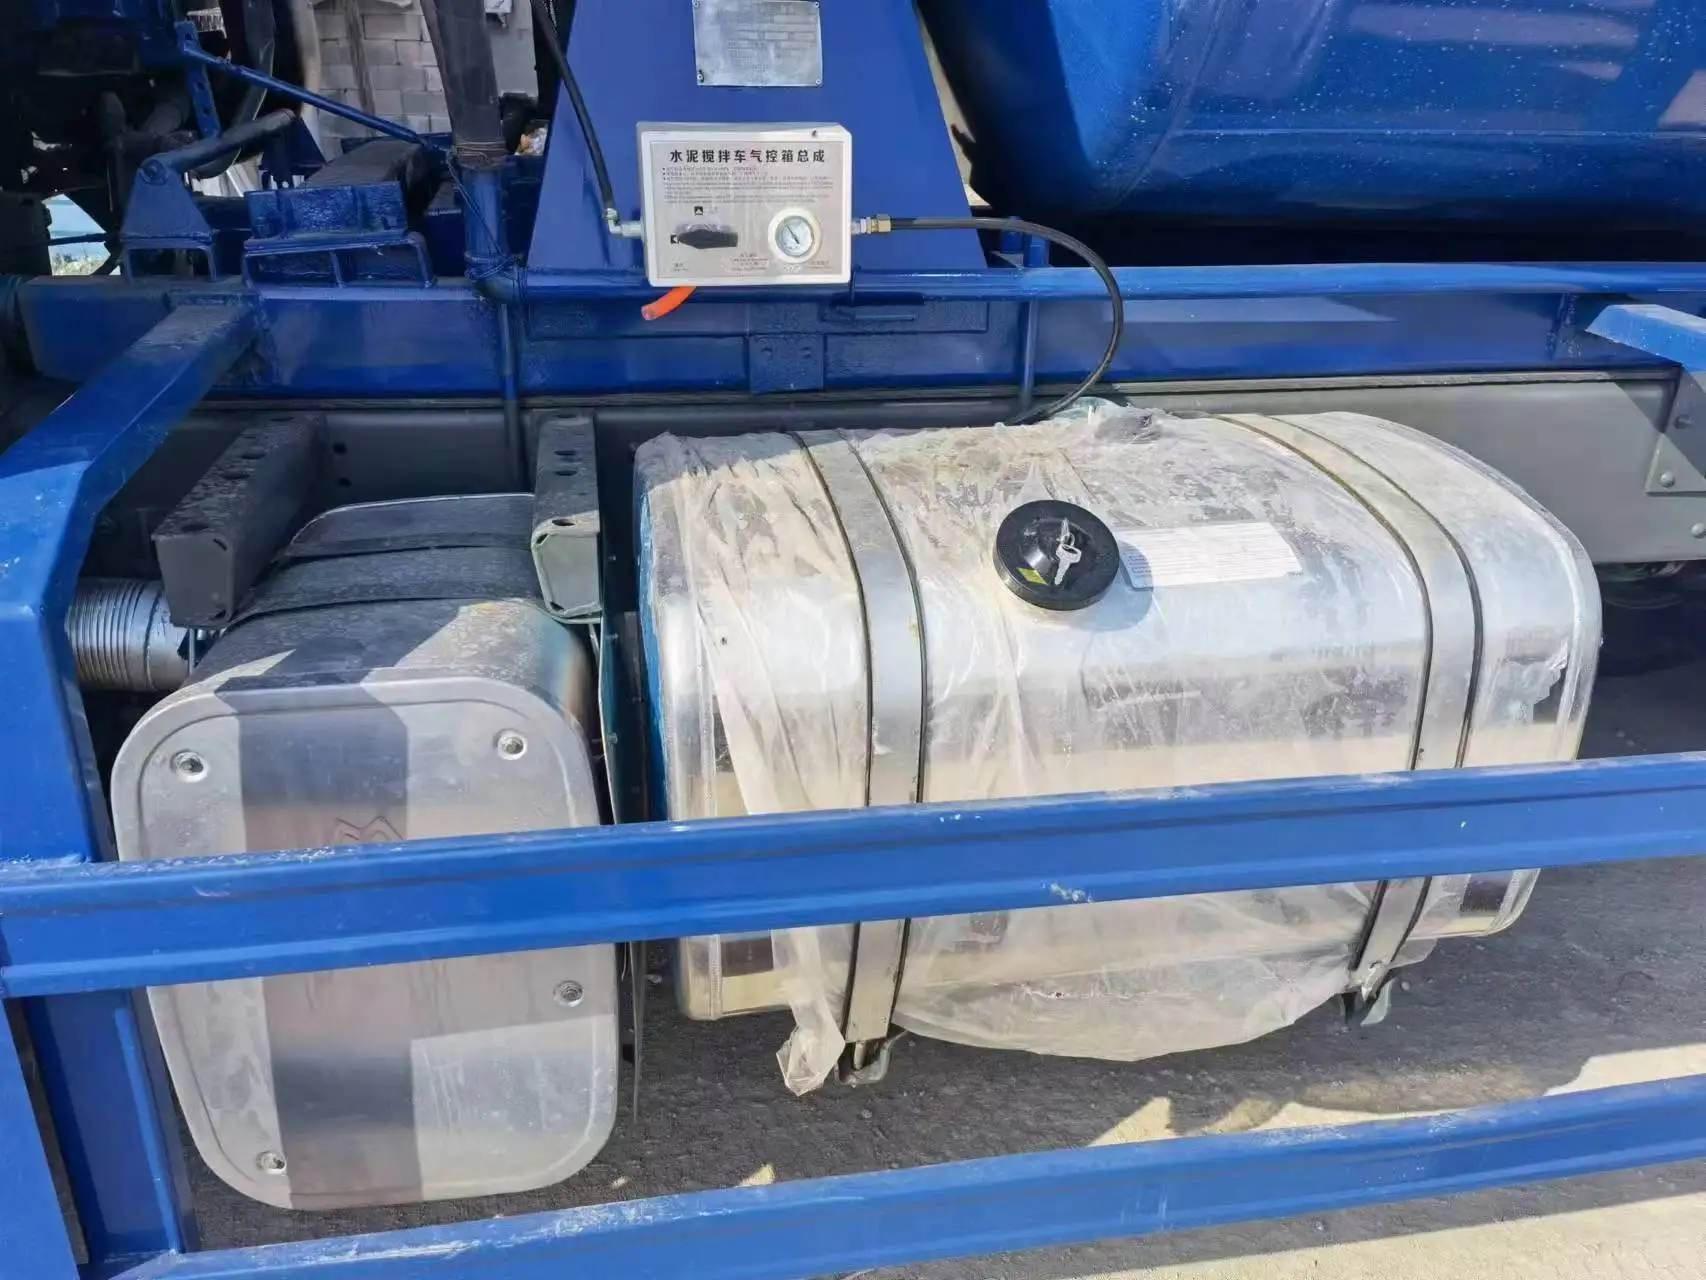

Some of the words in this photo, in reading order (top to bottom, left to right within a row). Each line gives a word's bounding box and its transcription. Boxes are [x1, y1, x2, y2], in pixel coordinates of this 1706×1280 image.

[670, 149, 825, 163] 水泥搅拌车气控箱总成
